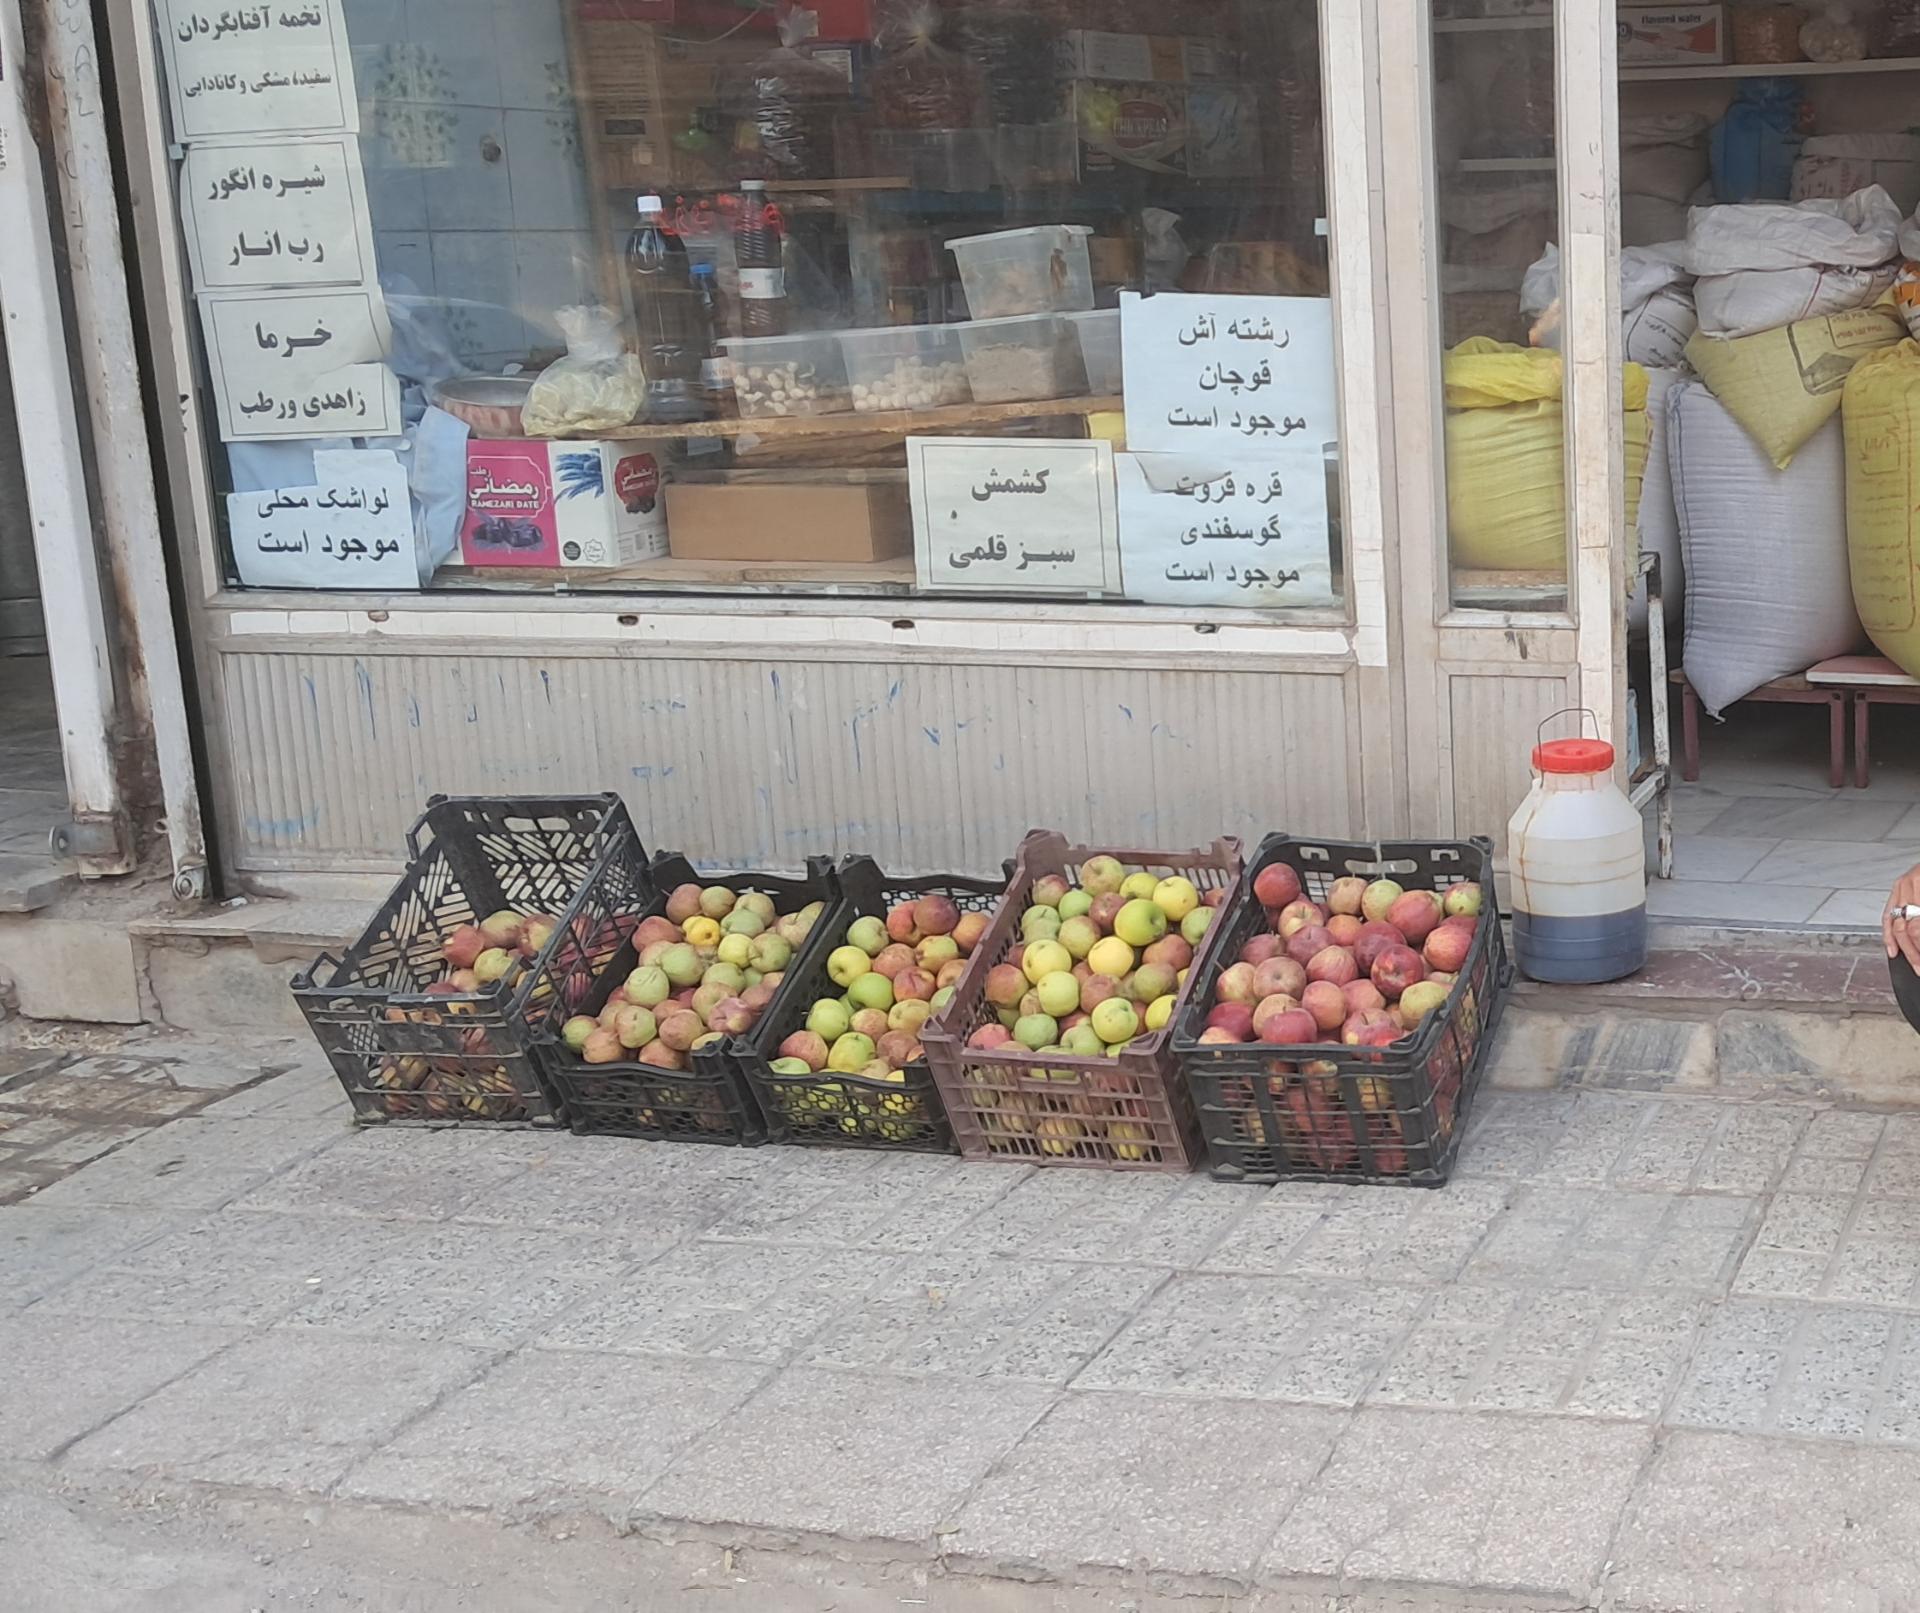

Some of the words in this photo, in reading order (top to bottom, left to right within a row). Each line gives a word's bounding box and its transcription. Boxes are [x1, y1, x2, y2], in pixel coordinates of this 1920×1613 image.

[177, 5, 270, 42] آفتابگردان
[279, 5, 321, 28] تخمه
[207, 164, 256, 200] انگور
[262, 164, 326, 198] شیره
[228, 229, 282, 266] انار
[288, 237, 324, 263] رب
[255, 318, 332, 358] خرما
[1178, 312, 1216, 346] آش
[1227, 316, 1290, 348] رشته
[1198, 358, 1272, 396] قوچان
[302, 386, 366, 418] زاهدی
[1167, 405, 1218, 428] است
[1230, 410, 1306, 437] موجود
[316, 486, 389, 515] لواشک
[971, 467, 1050, 502] کشمش
[1174, 471, 1236, 504] قروت
[1245, 471, 1283, 504] قره
[257, 488, 309, 518] محلی
[516, 499, 540, 509] DATE
[257, 529, 310, 554] است
[1180, 514, 1282, 547] گوسفندی
[320, 533, 400, 562] موجود
[949, 533, 1008, 569] قلمی
[1015, 541, 1076, 570] سبز
[1165, 561, 1215, 583] است
[1226, 564, 1300, 589] موجود
